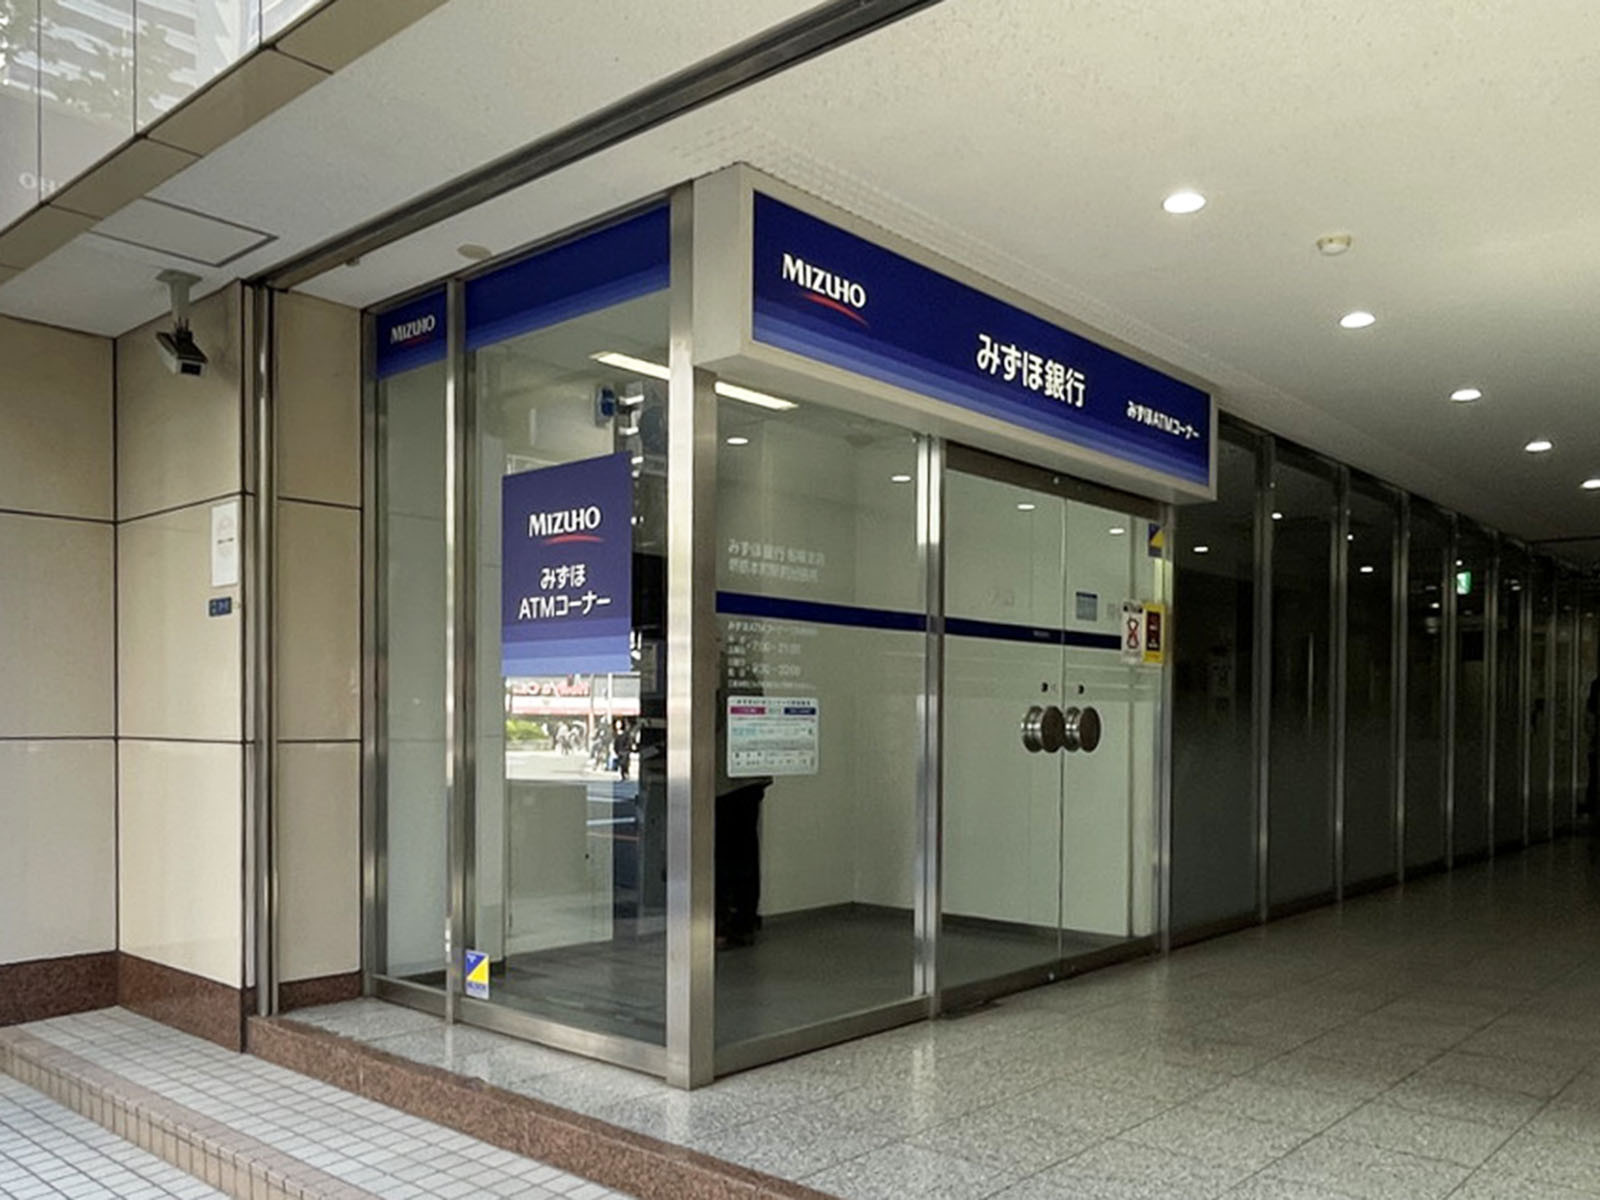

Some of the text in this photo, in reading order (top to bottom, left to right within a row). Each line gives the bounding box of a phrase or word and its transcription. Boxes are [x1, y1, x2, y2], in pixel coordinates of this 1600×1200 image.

[783, 253, 866, 308] MIZUHO
[391, 315, 436, 344] MIZUHO
[977, 334, 1085, 407] みずほ銀行
[1126, 401, 1199, 439] みずほATMコーナー
[528, 506, 601, 537] MIZUHO
[540, 564, 586, 590] みずほ
[518, 590, 611, 620] ATMコーナー
